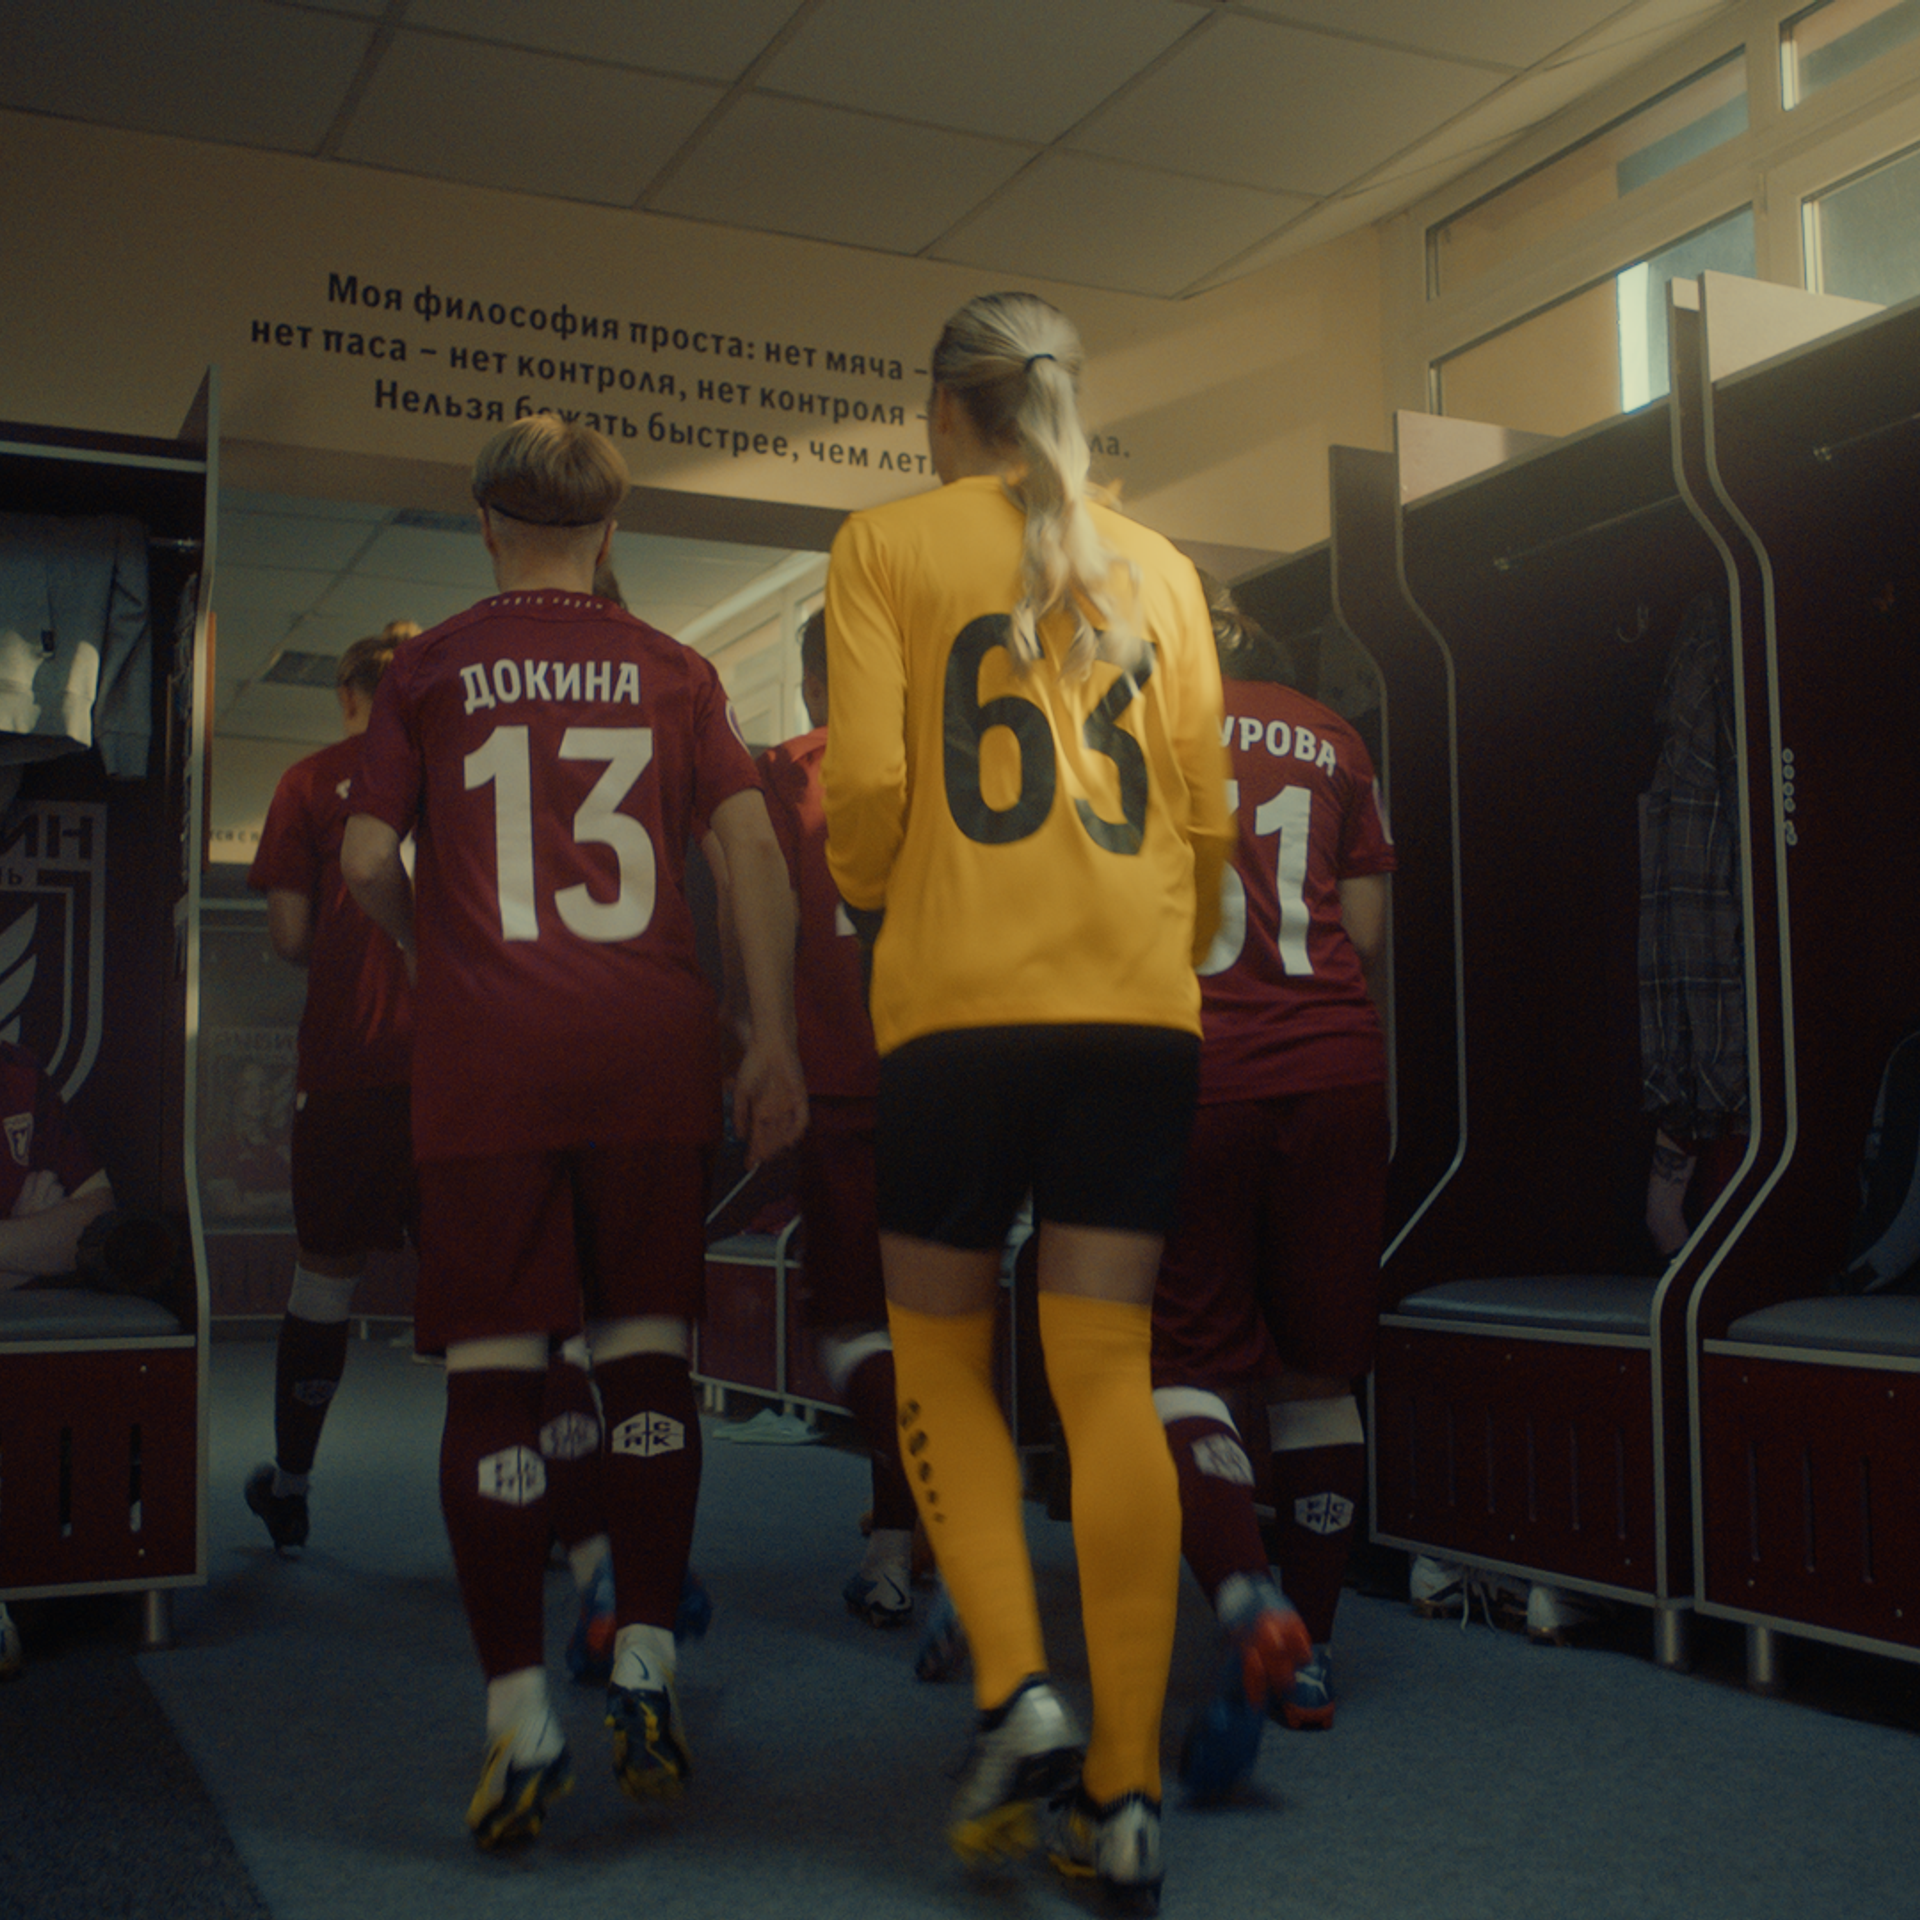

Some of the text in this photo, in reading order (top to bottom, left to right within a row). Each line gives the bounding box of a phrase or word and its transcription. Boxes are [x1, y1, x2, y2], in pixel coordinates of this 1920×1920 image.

[251, 320, 312, 349] нет
[323, 328, 407, 361] паса
[449, 347, 508, 374] нет
[517, 356, 687, 401] контроля,
[698, 379, 750, 406] нет
[760, 385, 905, 427] контроля
[327, 272, 402, 311] Моя
[413, 284, 619, 341] философия
[629, 322, 755, 360] проста:
[764, 340, 816, 368] нет
[826, 349, 903, 381] мяча
[374, 379, 504, 422] Нельзя
[648, 411, 799, 461] быстрее,
[808, 439, 869, 468] чем
[460, 658, 640, 716] ДОКИНА
[943, 613, 1150, 856] 63
[463, 724, 657, 944] 13
